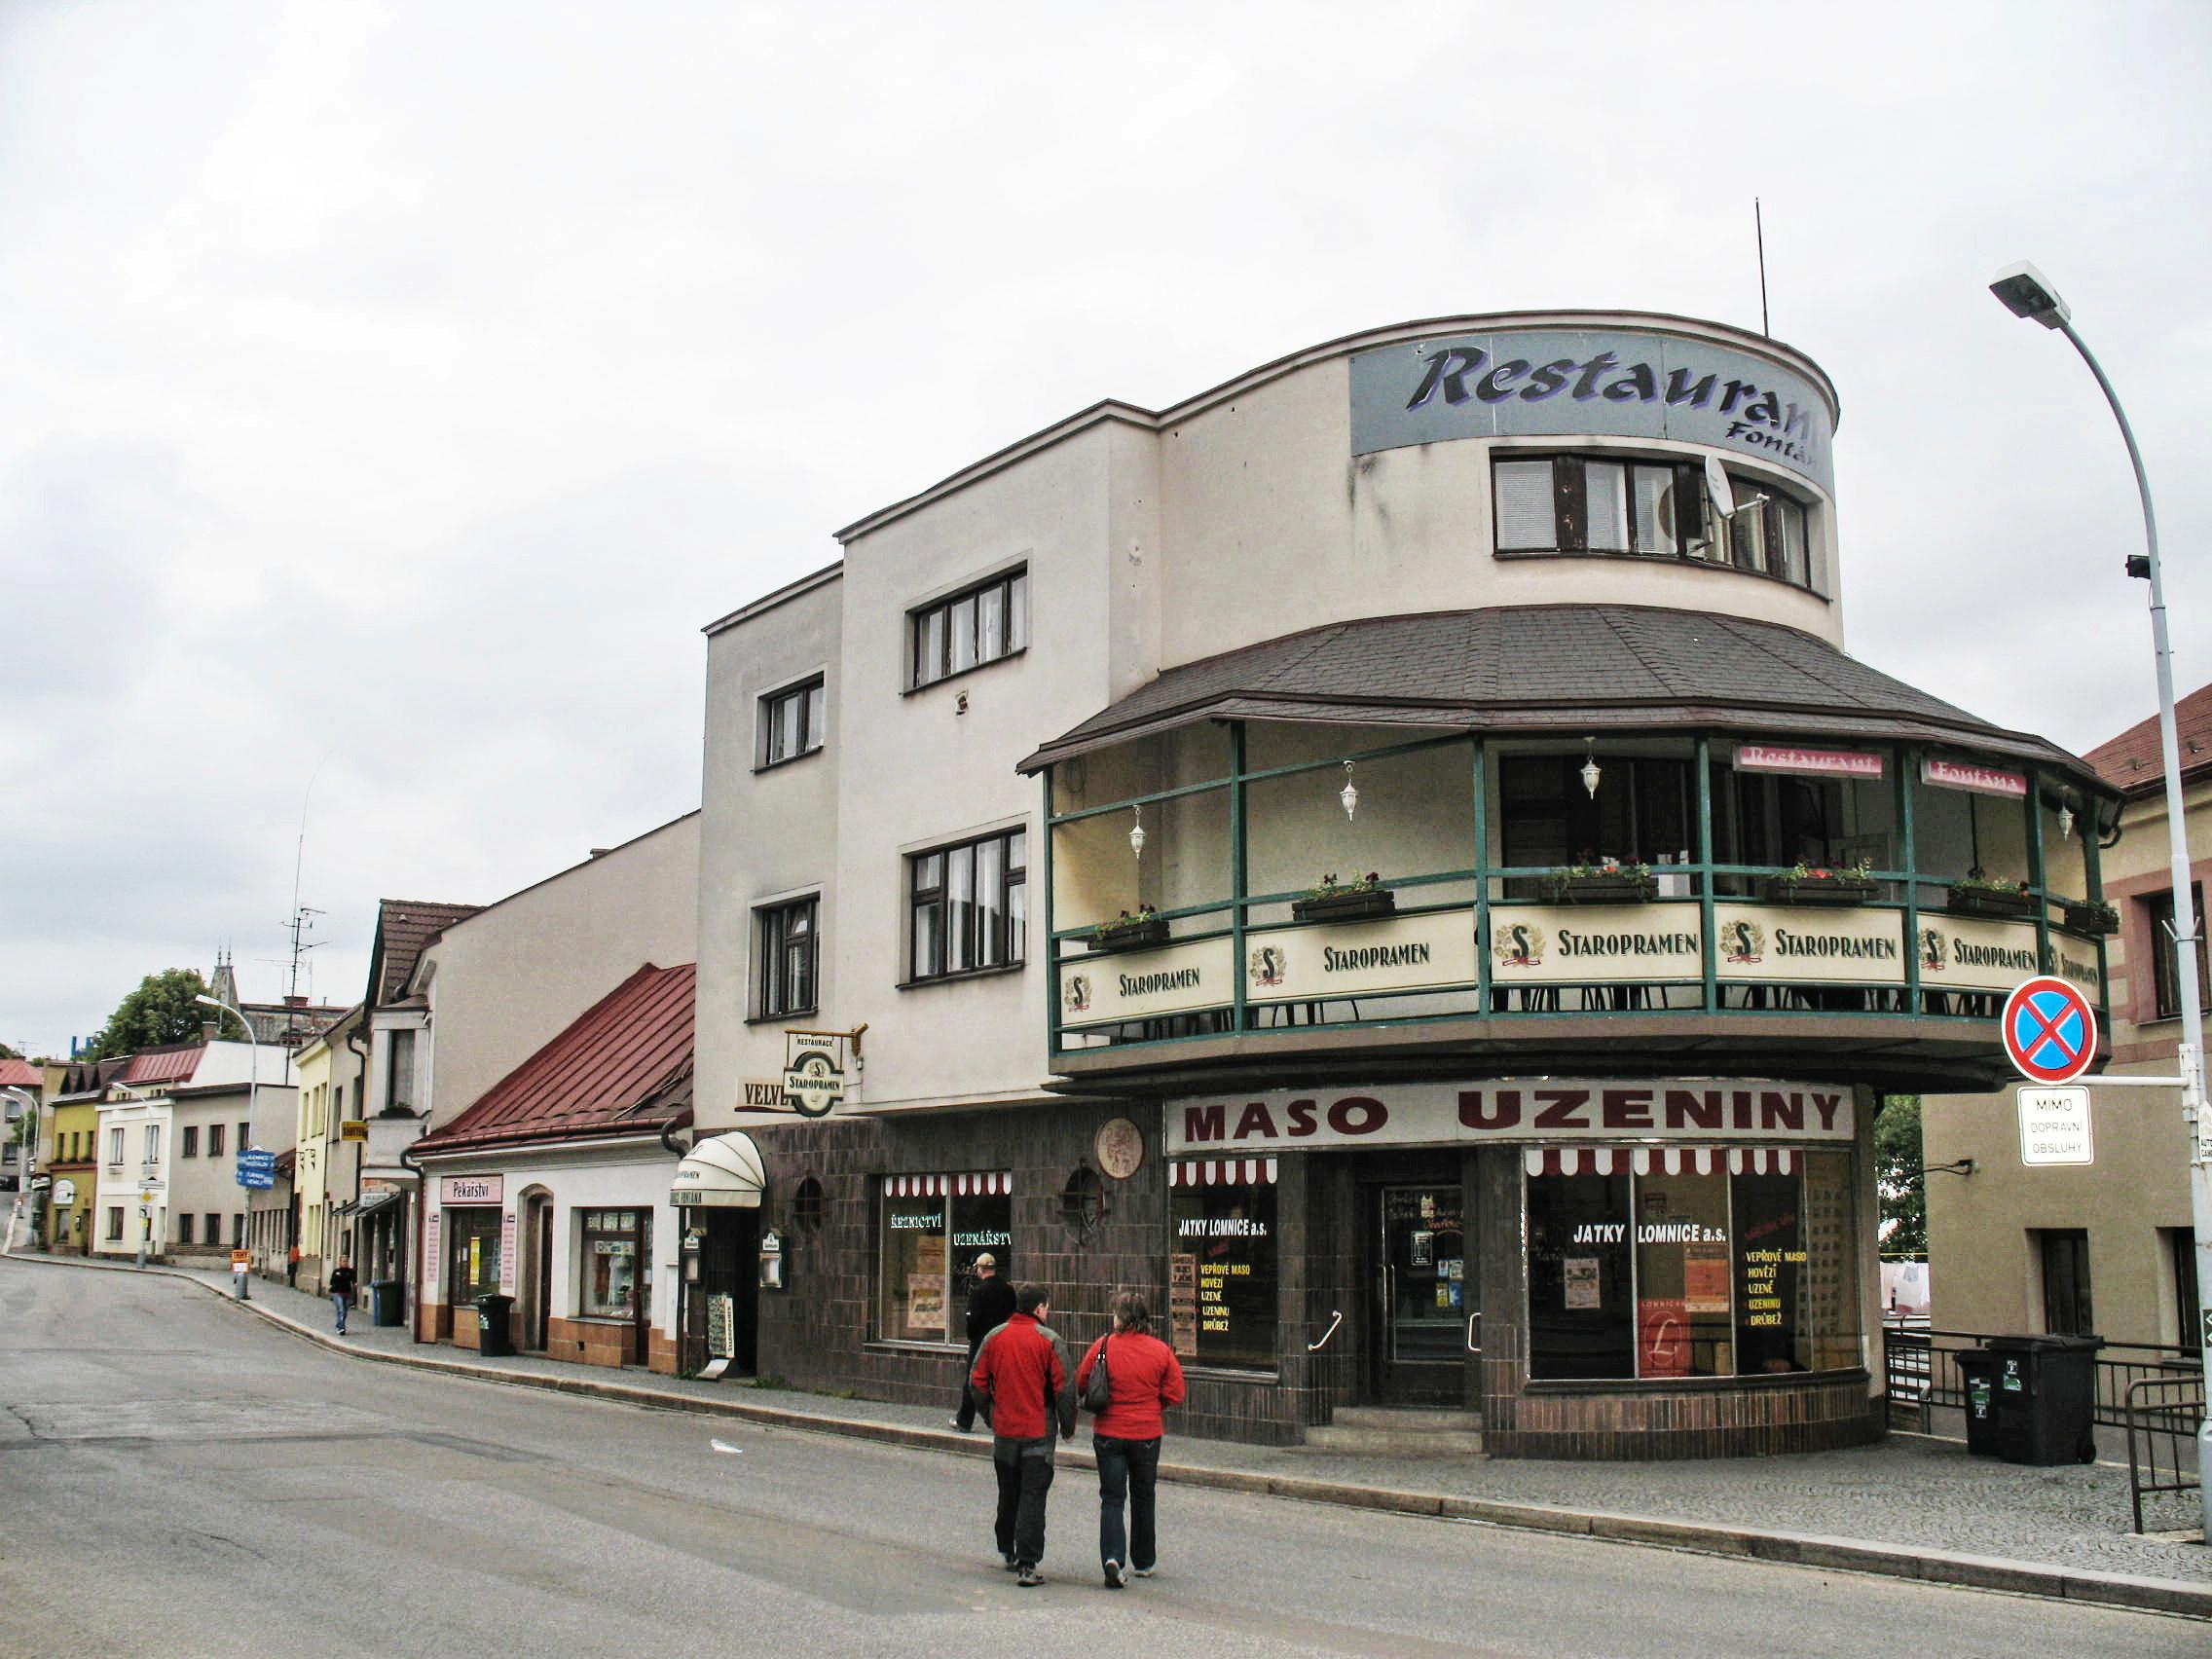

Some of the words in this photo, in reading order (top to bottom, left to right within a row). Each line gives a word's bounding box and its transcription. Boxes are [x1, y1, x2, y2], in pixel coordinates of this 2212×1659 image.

[1405, 346, 1823, 440] Restauran
[1724, 421, 1823, 467] Fontán
[1749, 746, 1874, 773] Restaurant
[1558, 929, 1698, 957] STAROPRAMEN
[1775, 928, 1897, 960] STAROPRAMEN
[1953, 938, 2037, 972] STAROPRAMEN
[1323, 941, 1431, 973] STAROPRAMEN
[1119, 967, 1200, 997] STAROPRAMEN
[745, 1083, 794, 1106] VELVE
[789, 1075, 840, 1091] STAROPRAMEN
[1185, 1096, 1388, 1142] MASO
[1457, 1089, 1842, 1130] UZENINY
[2036, 1099, 2073, 1112] MIMO
[2030, 1121, 2083, 1133] DOPRAVNÍ
[2033, 1142, 2083, 1154] OBSLUHY
[953, 1230, 1012, 1246] UZENÁŘSTV
[1178, 1219, 1207, 1236] JATKY
[1209, 1218, 1249, 1236] LOMNICE
[1250, 1222, 1268, 1235] a.s.
[1573, 1224, 1625, 1243] JATKY
[1638, 1224, 1700, 1243] LOMNICE
[1703, 1226, 1726, 1242] a.s.
[1746, 1248, 1783, 1263] VEPŘOVÉ
